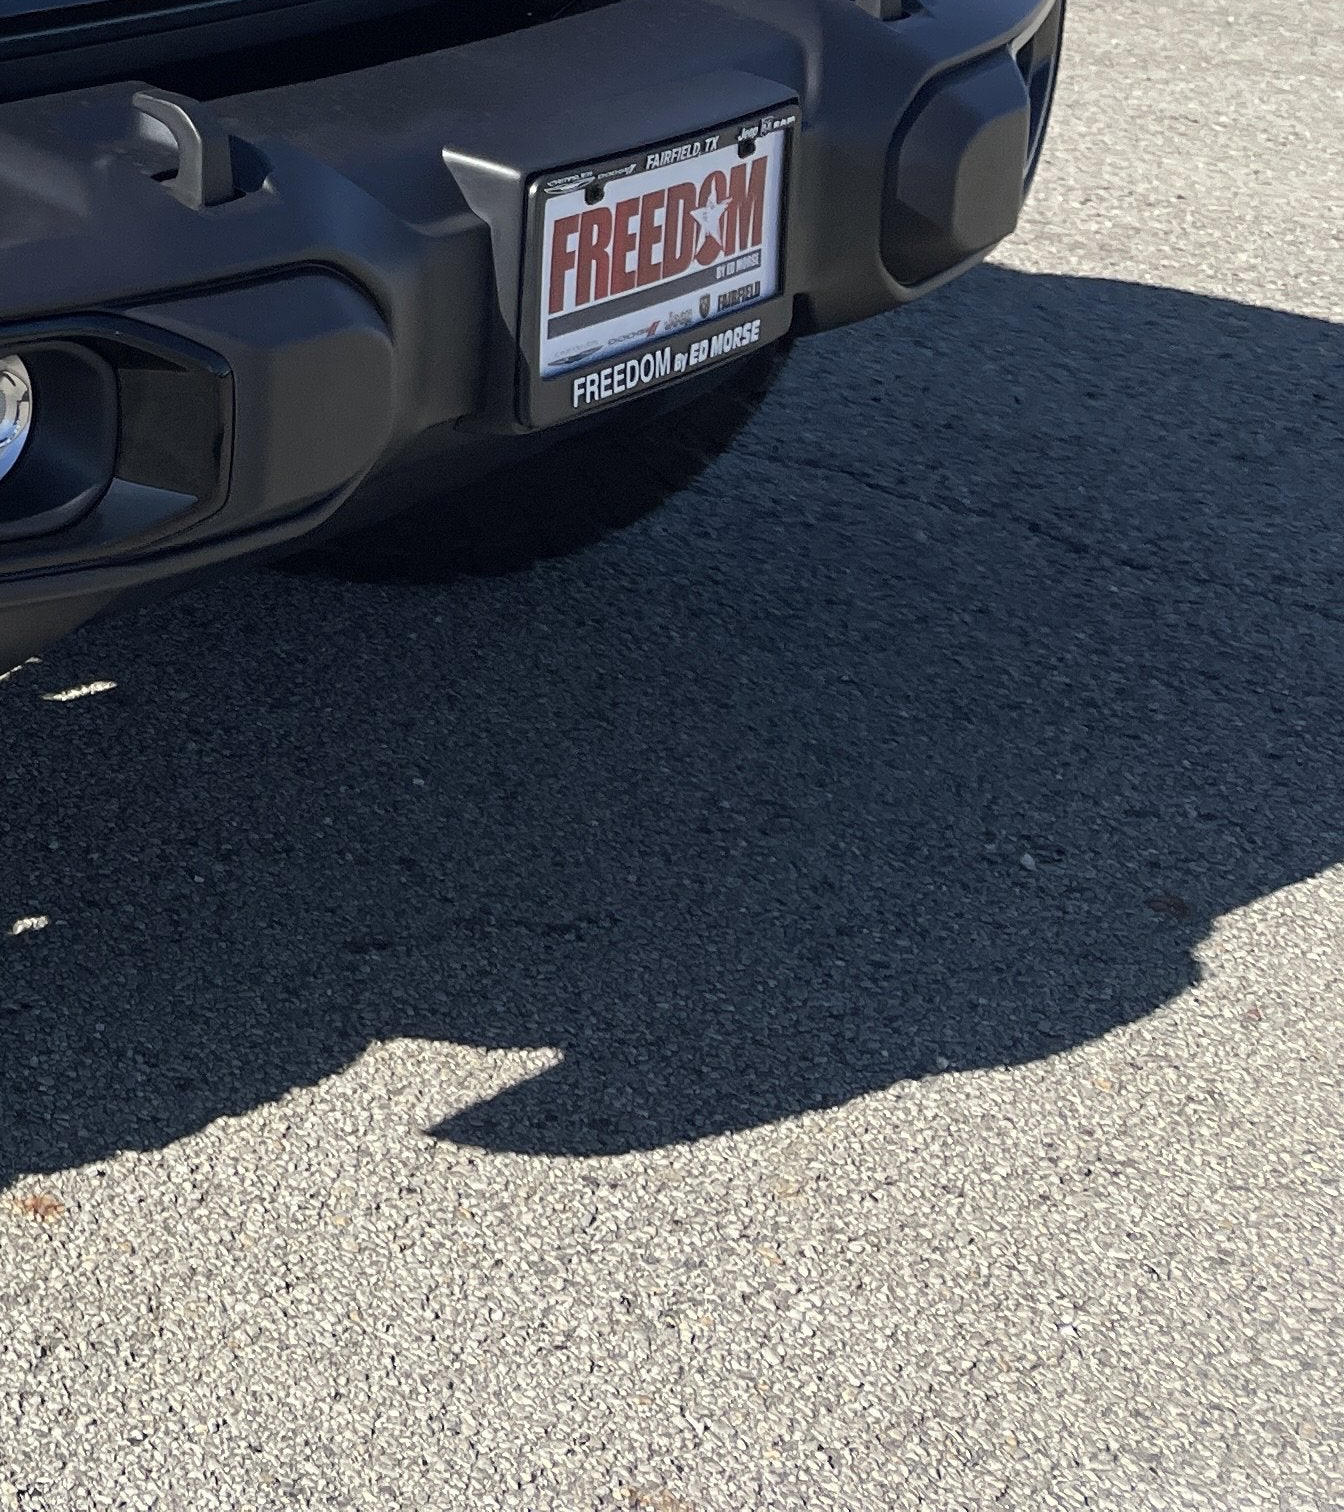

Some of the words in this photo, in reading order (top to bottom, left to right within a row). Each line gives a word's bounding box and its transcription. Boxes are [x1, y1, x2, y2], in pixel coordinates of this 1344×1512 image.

[705, 135, 719, 151] TX
[773, 116, 795, 128] RAM
[549, 155, 768, 315] FREEDOM
[573, 347, 671, 408] FREEDOM
[689, 339, 709, 365] ED
[709, 319, 761, 358] MORSE
